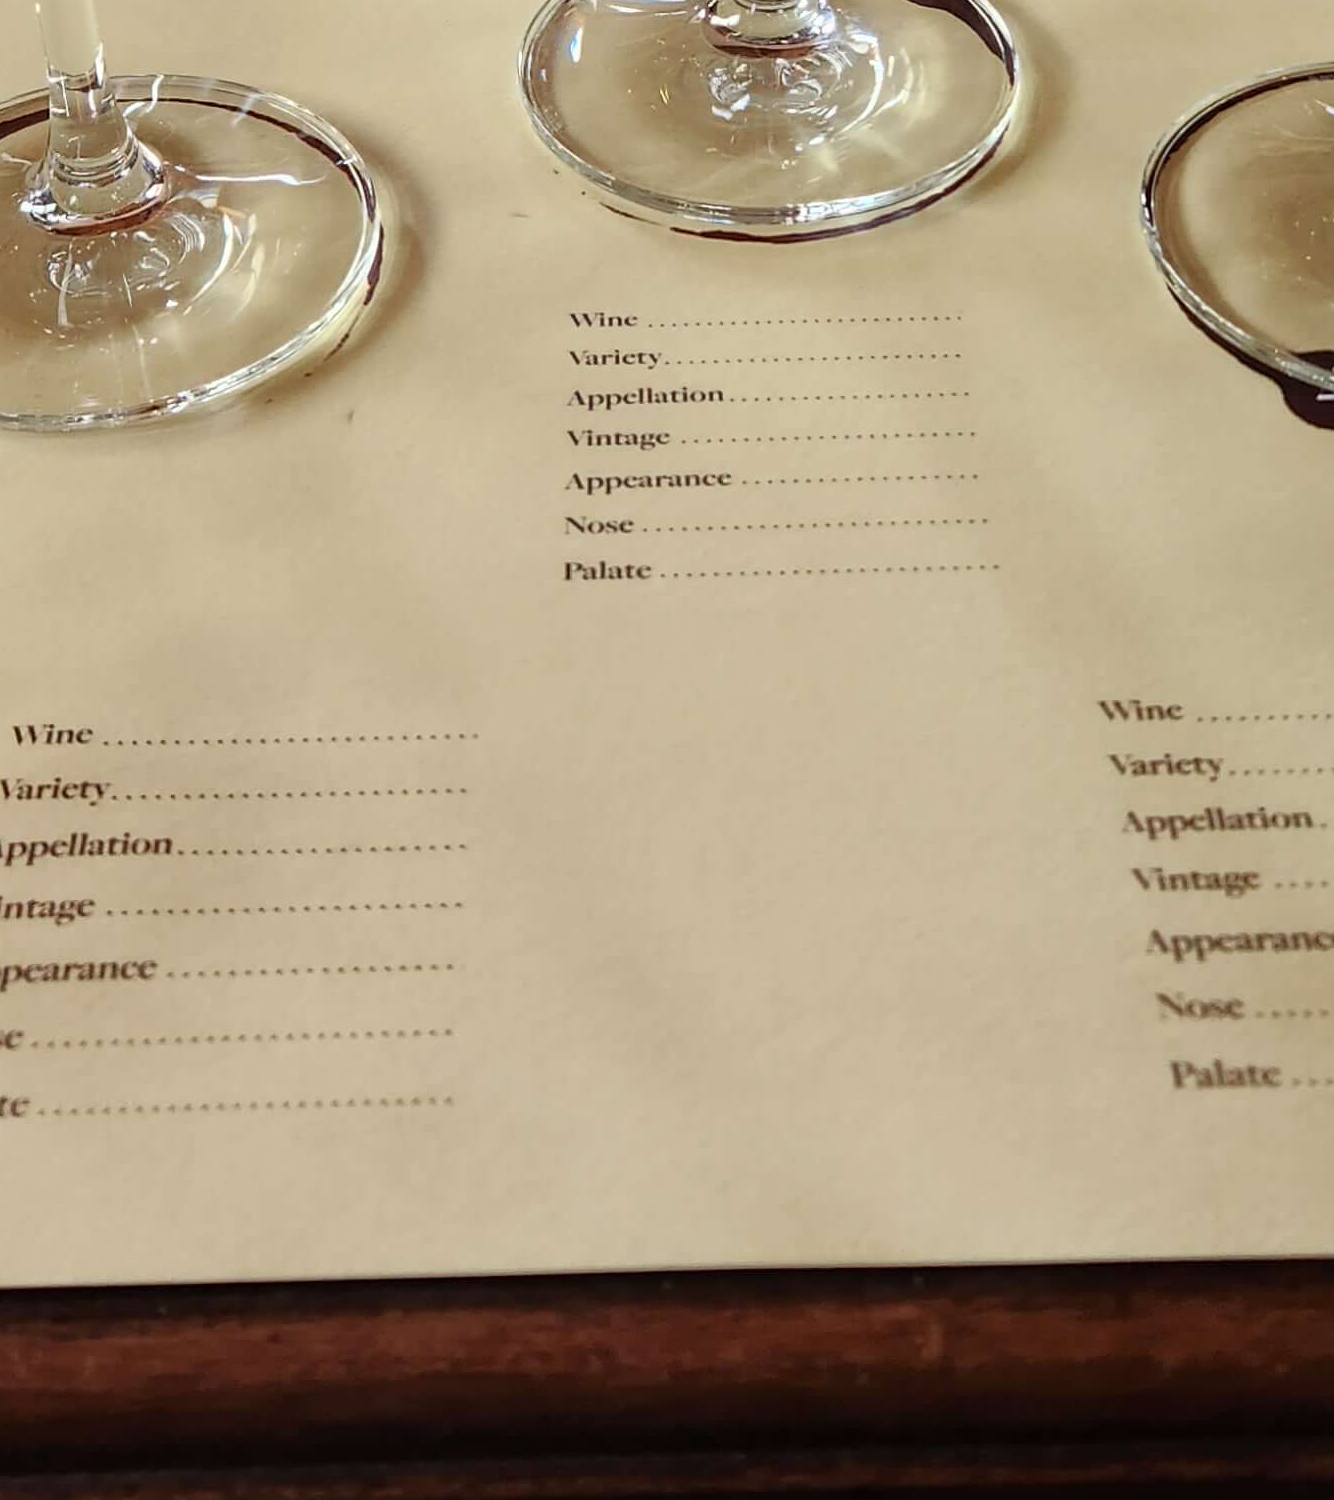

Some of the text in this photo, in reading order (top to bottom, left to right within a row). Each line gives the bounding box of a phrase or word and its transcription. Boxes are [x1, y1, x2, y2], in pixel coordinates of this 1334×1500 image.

[570, 312, 638, 329] Wine
[570, 350, 662, 369] Variety
[567, 386, 724, 411] Appellation
[567, 429, 671, 451] Vintage
[565, 471, 732, 495] Appearance
[564, 516, 635, 536] Nose
[564, 561, 652, 582] Palate
[1099, 699, 1184, 723] Wine
[12, 723, 93, 747] Wine
[1109, 754, 1223, 782] Variety
[1122, 807, 1314, 840] Appellation
[1132, 867, 1260, 899] Vintage
[1157, 991, 1245, 1021] Nose
[1170, 1058, 1282, 1090] Palate
